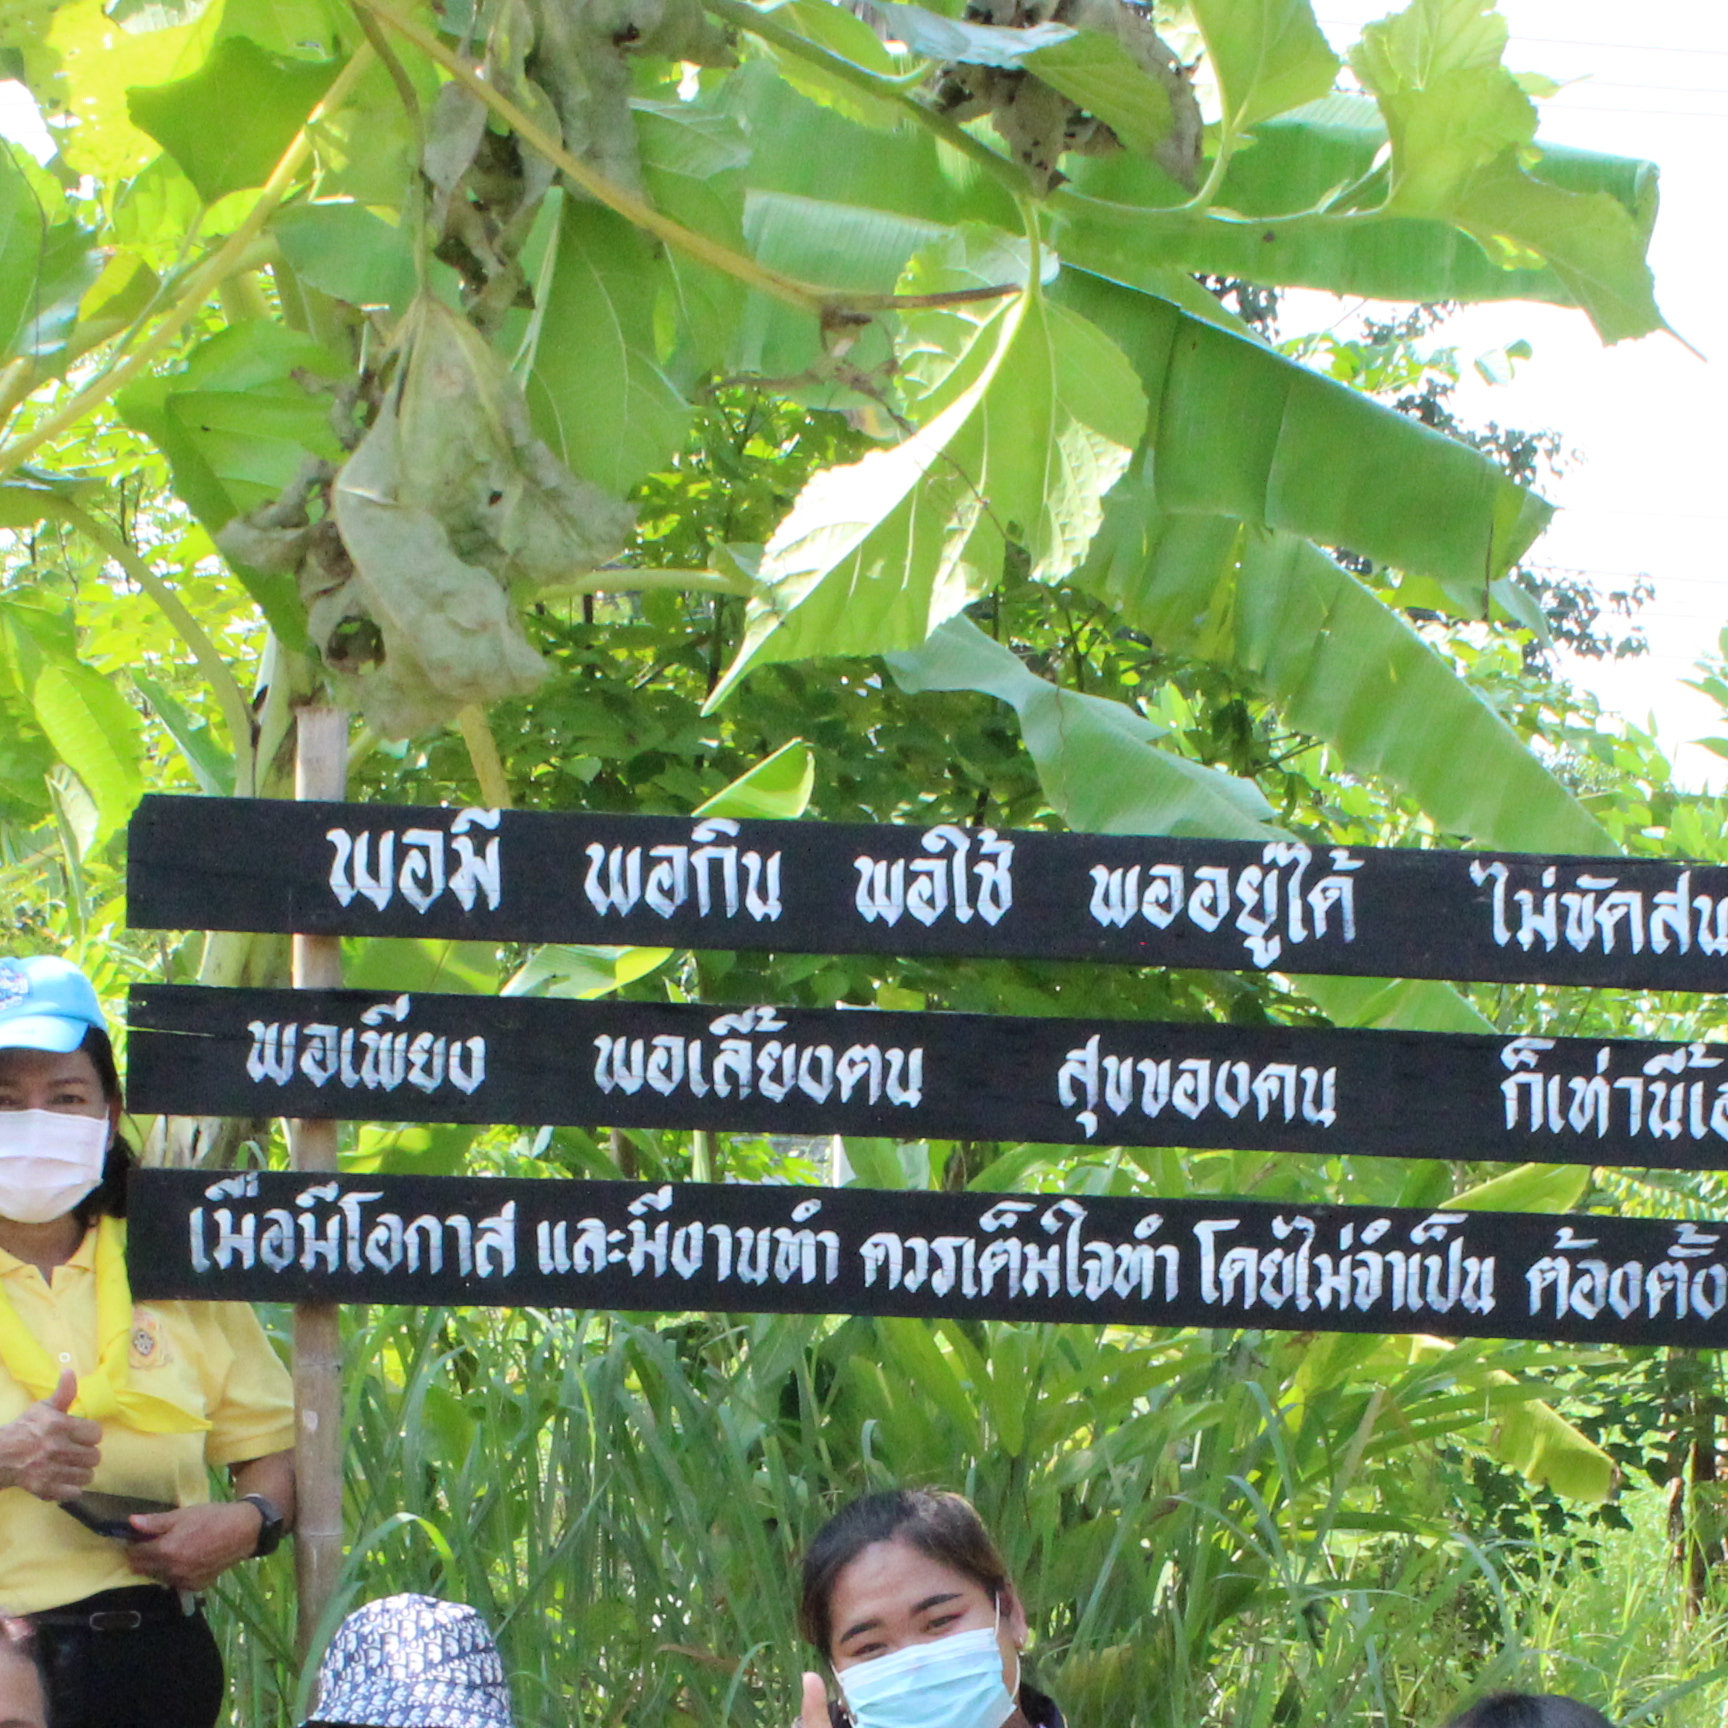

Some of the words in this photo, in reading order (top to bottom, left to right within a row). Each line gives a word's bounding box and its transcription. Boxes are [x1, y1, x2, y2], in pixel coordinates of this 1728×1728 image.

[325, 805, 502, 913] พอมี
[584, 818, 783, 922] พอกิน
[245, 995, 487, 1095] พอเพียง
[188, 1171, 517, 1278] เมื่อมีโอกาส
[536, 1184, 840, 1286] และมีงานทำ
